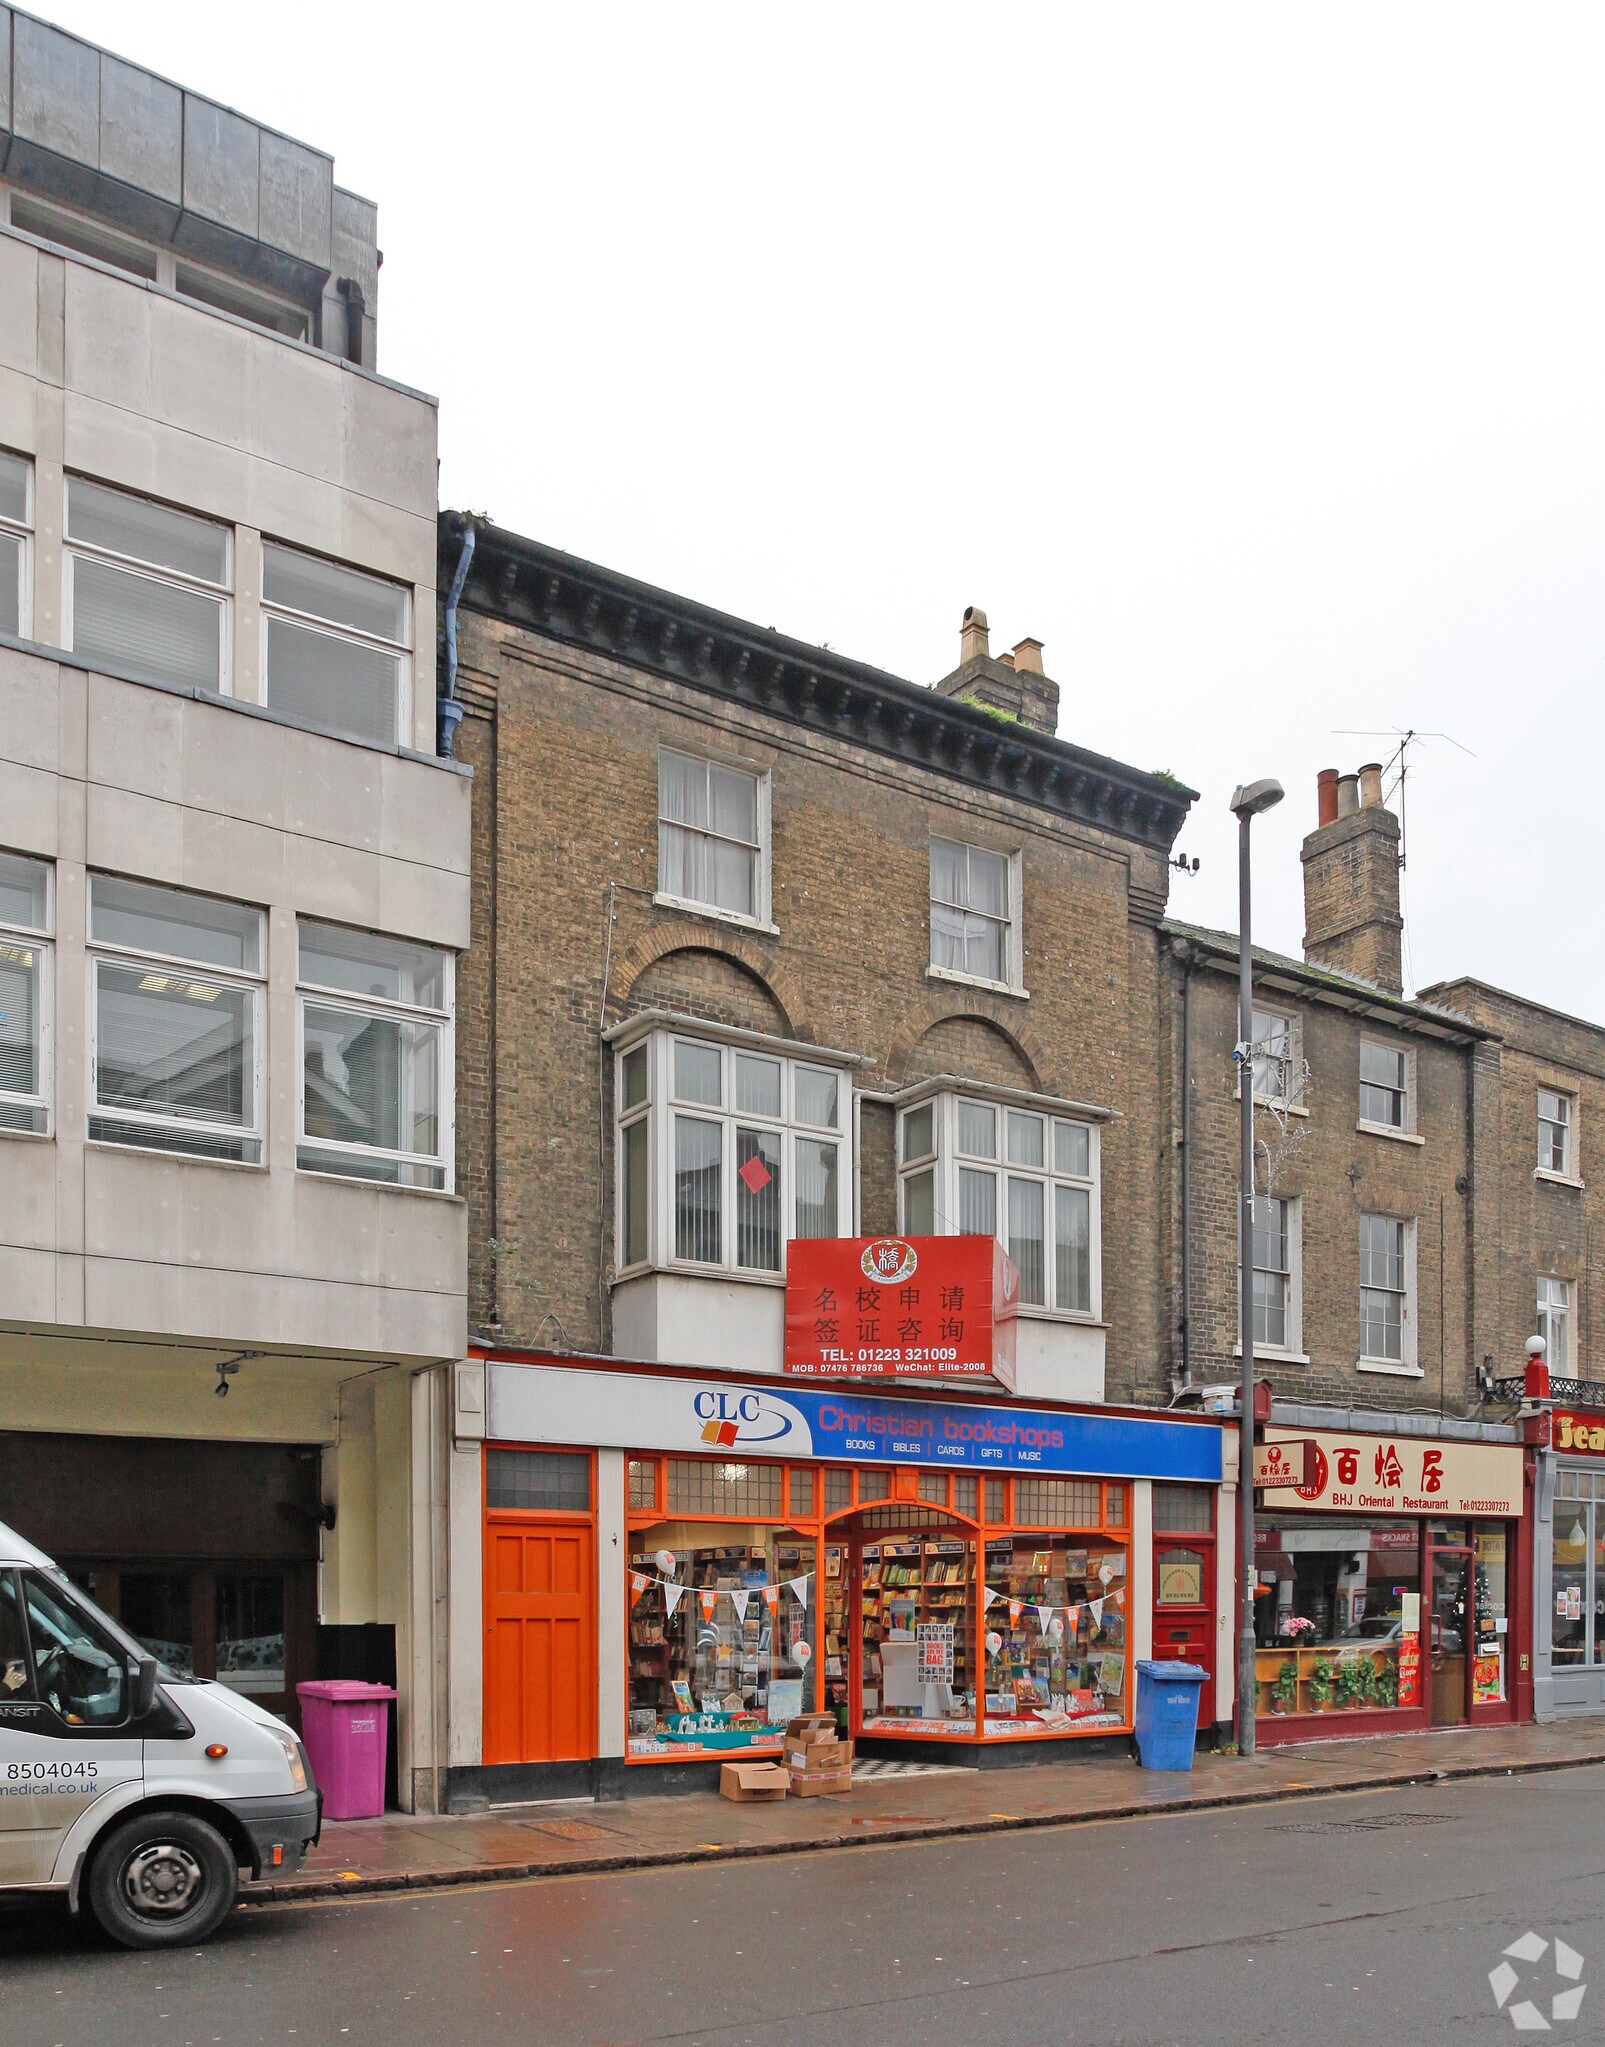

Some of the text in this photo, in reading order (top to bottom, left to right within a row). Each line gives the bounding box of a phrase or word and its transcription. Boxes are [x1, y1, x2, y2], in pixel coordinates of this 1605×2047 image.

[813, 1286, 965, 1312] 名校申请
[813, 1317, 965, 1343] 签证咨询
[820, 1347, 957, 1361] TEL: 01223 321009
[792, 1363, 884, 1373] MOB: 07476 786736
[895, 1362, 986, 1372] WeChat: Elite-2008
[693, 1391, 760, 1422] CLC
[818, 1405, 1064, 1450] Christian bookshops
[845, 1439, 1042, 1461] BOOKS BIBLES CARDS GIFTS MUSIC
[1259, 1462, 1291, 1475] 百烩居
[1332, 1444, 1444, 1492] 百烩居
[1253, 1476, 1298, 1486] Tel:01223307273
[1332, 1493, 1510, 1512] BHJ Oriental Restaurant Tel:01223307273
[926, 1655, 944, 1665] BAG
[7, 1762, 98, 1779] 8504045
